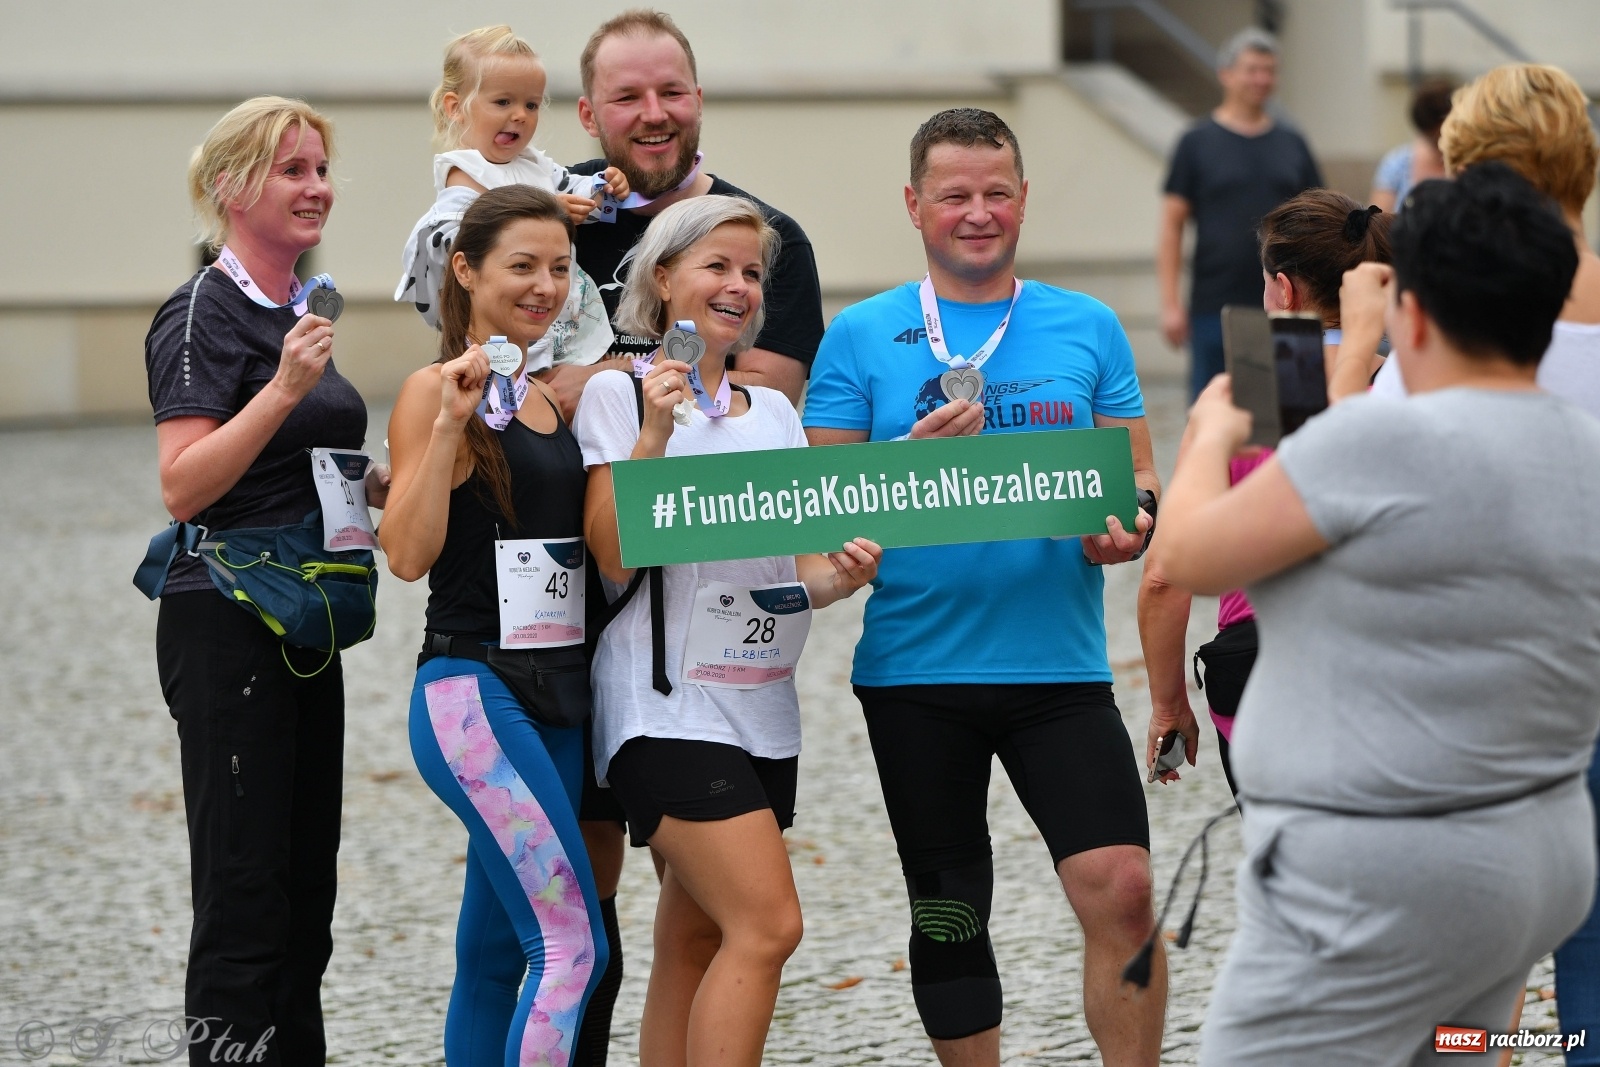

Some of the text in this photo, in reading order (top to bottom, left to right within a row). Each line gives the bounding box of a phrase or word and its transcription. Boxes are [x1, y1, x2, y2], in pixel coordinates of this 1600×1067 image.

[984, 382, 1019, 396] NGS
[983, 401, 1073, 430] RLD RUN
[651, 461, 1104, 529] #FundacjaKobietaNiezalezna
[544, 571, 569, 600] 43
[742, 616, 776, 644] 28
